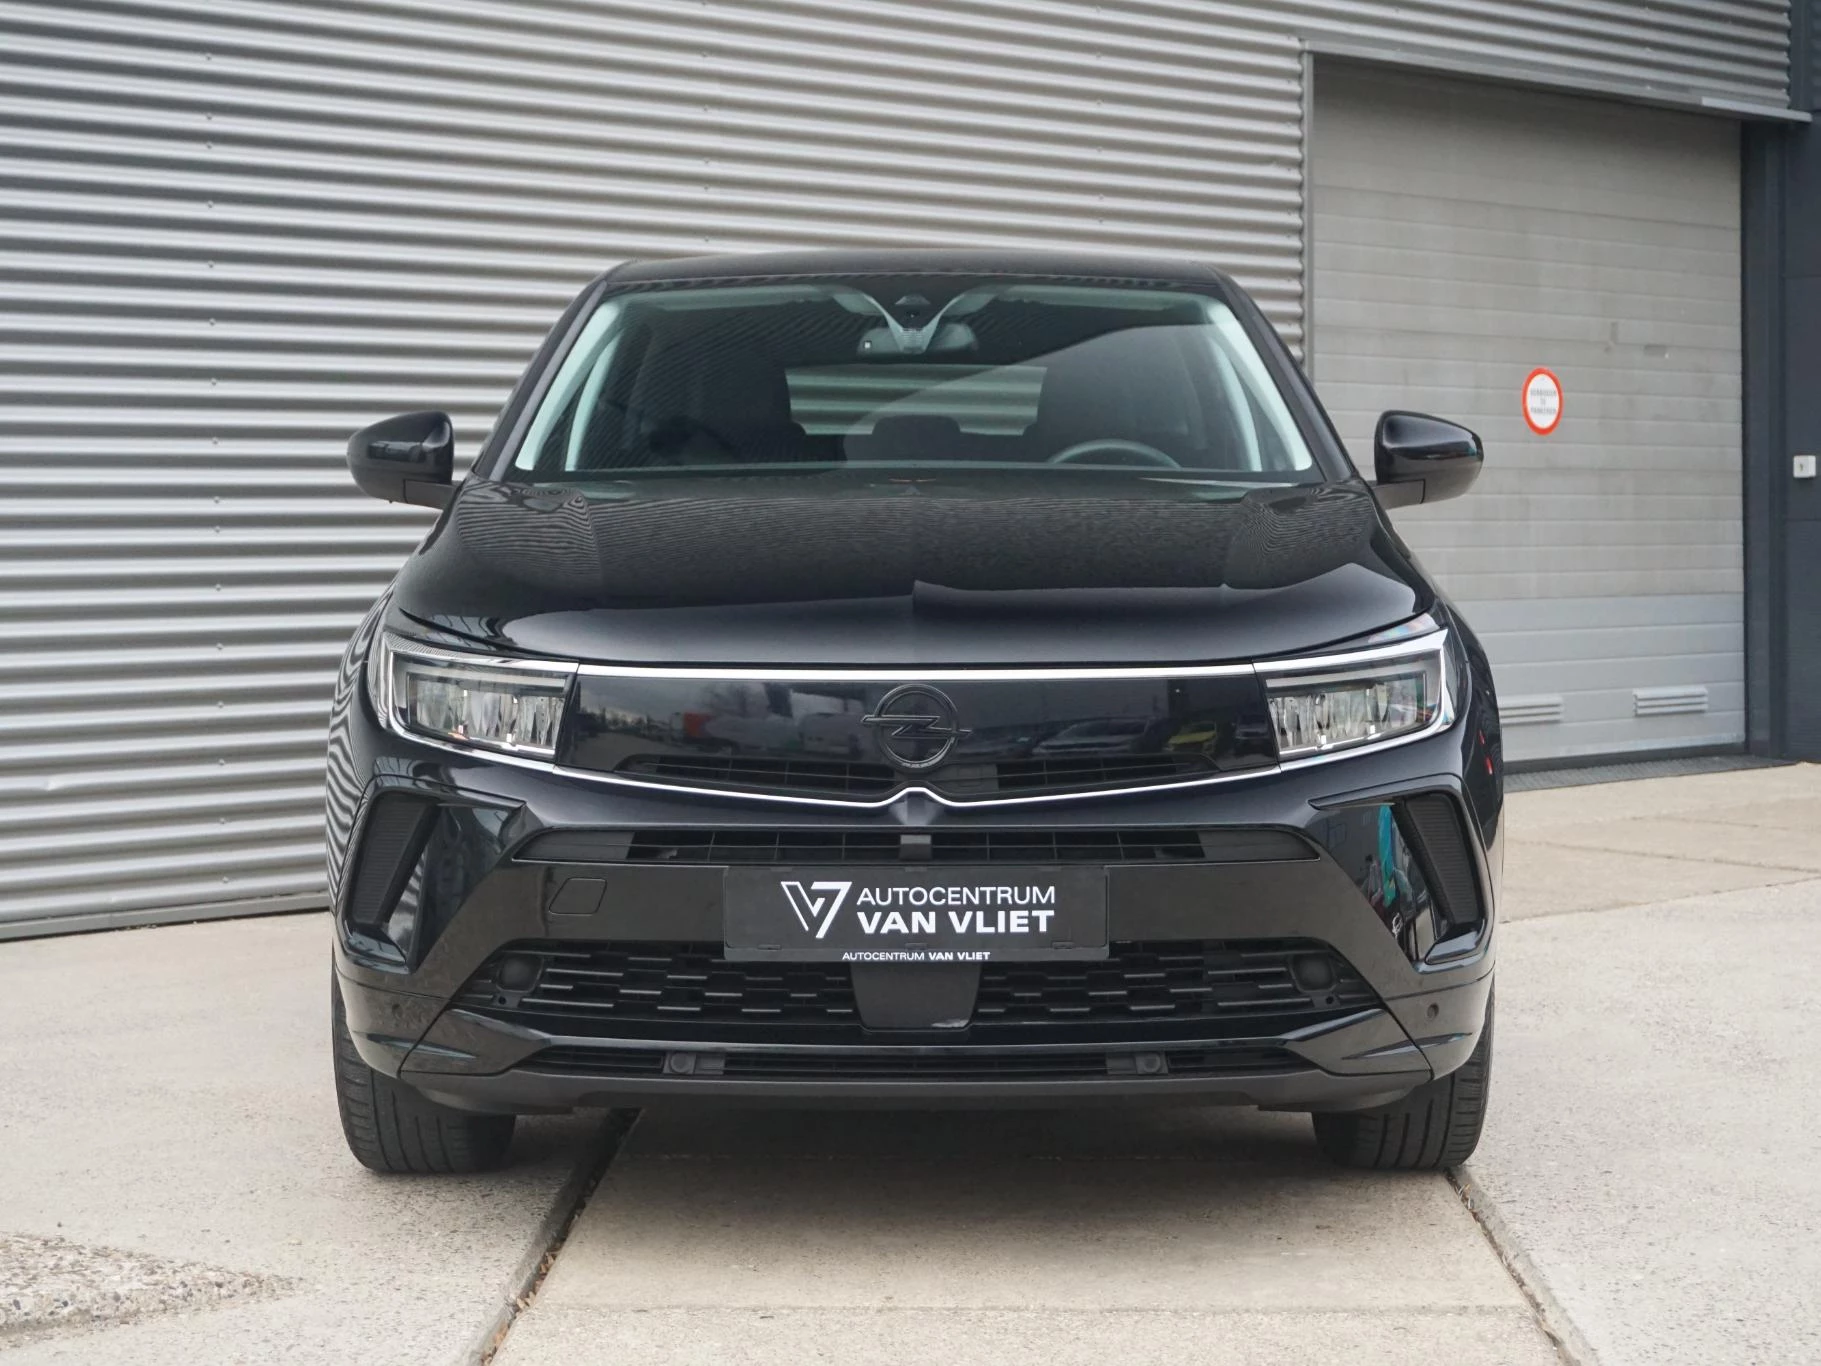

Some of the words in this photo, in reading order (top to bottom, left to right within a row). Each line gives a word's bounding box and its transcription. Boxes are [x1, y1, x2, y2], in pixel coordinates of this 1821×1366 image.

[856, 885, 1056, 906] AUTOCENTRUM
[856, 911, 937, 935] VAN
[947, 909, 1056, 934] VLIET
[841, 951, 925, 962] AUTOCENTRUM
[927, 951, 954, 962] VAN
[956, 951, 991, 961] VLIET
